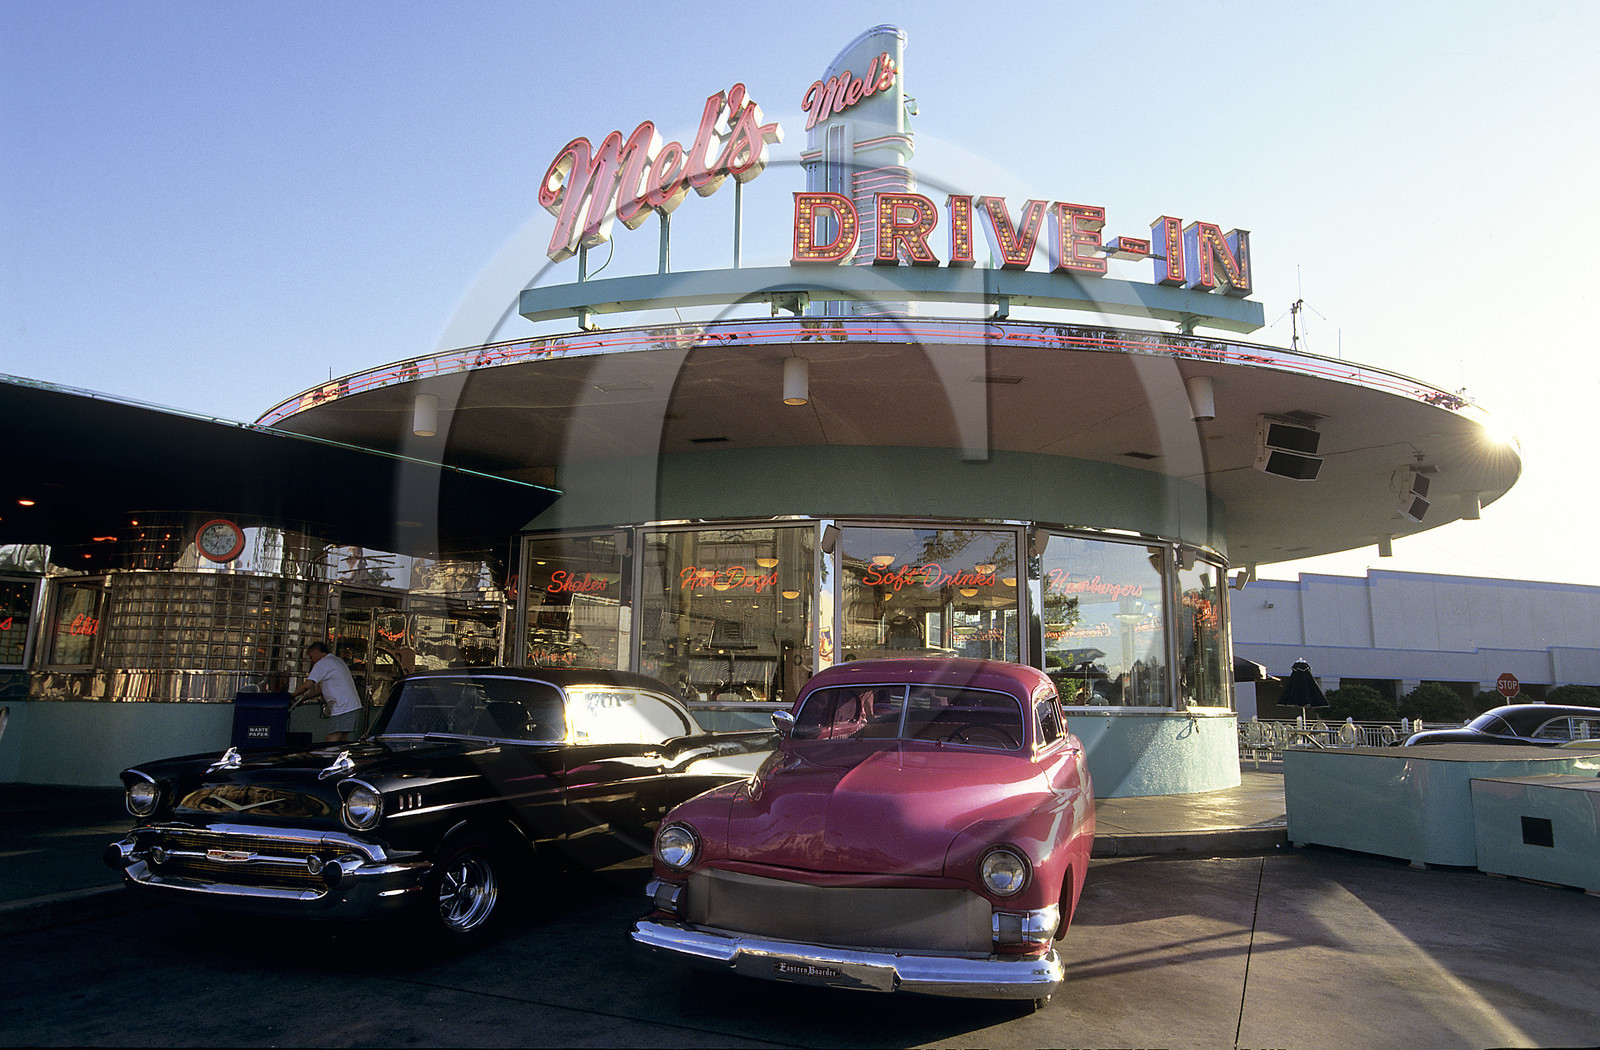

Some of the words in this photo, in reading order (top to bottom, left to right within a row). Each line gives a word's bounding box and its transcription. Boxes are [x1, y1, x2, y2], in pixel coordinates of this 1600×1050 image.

[801, 51, 898, 131] Mel's
[538, 82, 785, 262] Mel's
[791, 191, 1252, 299] DRIVE-IN
[547, 570, 608, 593] Shakes
[680, 566, 723, 591] Hot
[725, 565, 778, 594] Dogs
[862, 562, 919, 592] Soft
[920, 562, 997, 588] Drinks
[1049, 568, 1143, 601] Hamburgers
[1498, 680, 1517, 689] STOP
[779, 962, 808, 974] Eastern
[808, 965, 837, 977] Boarder
